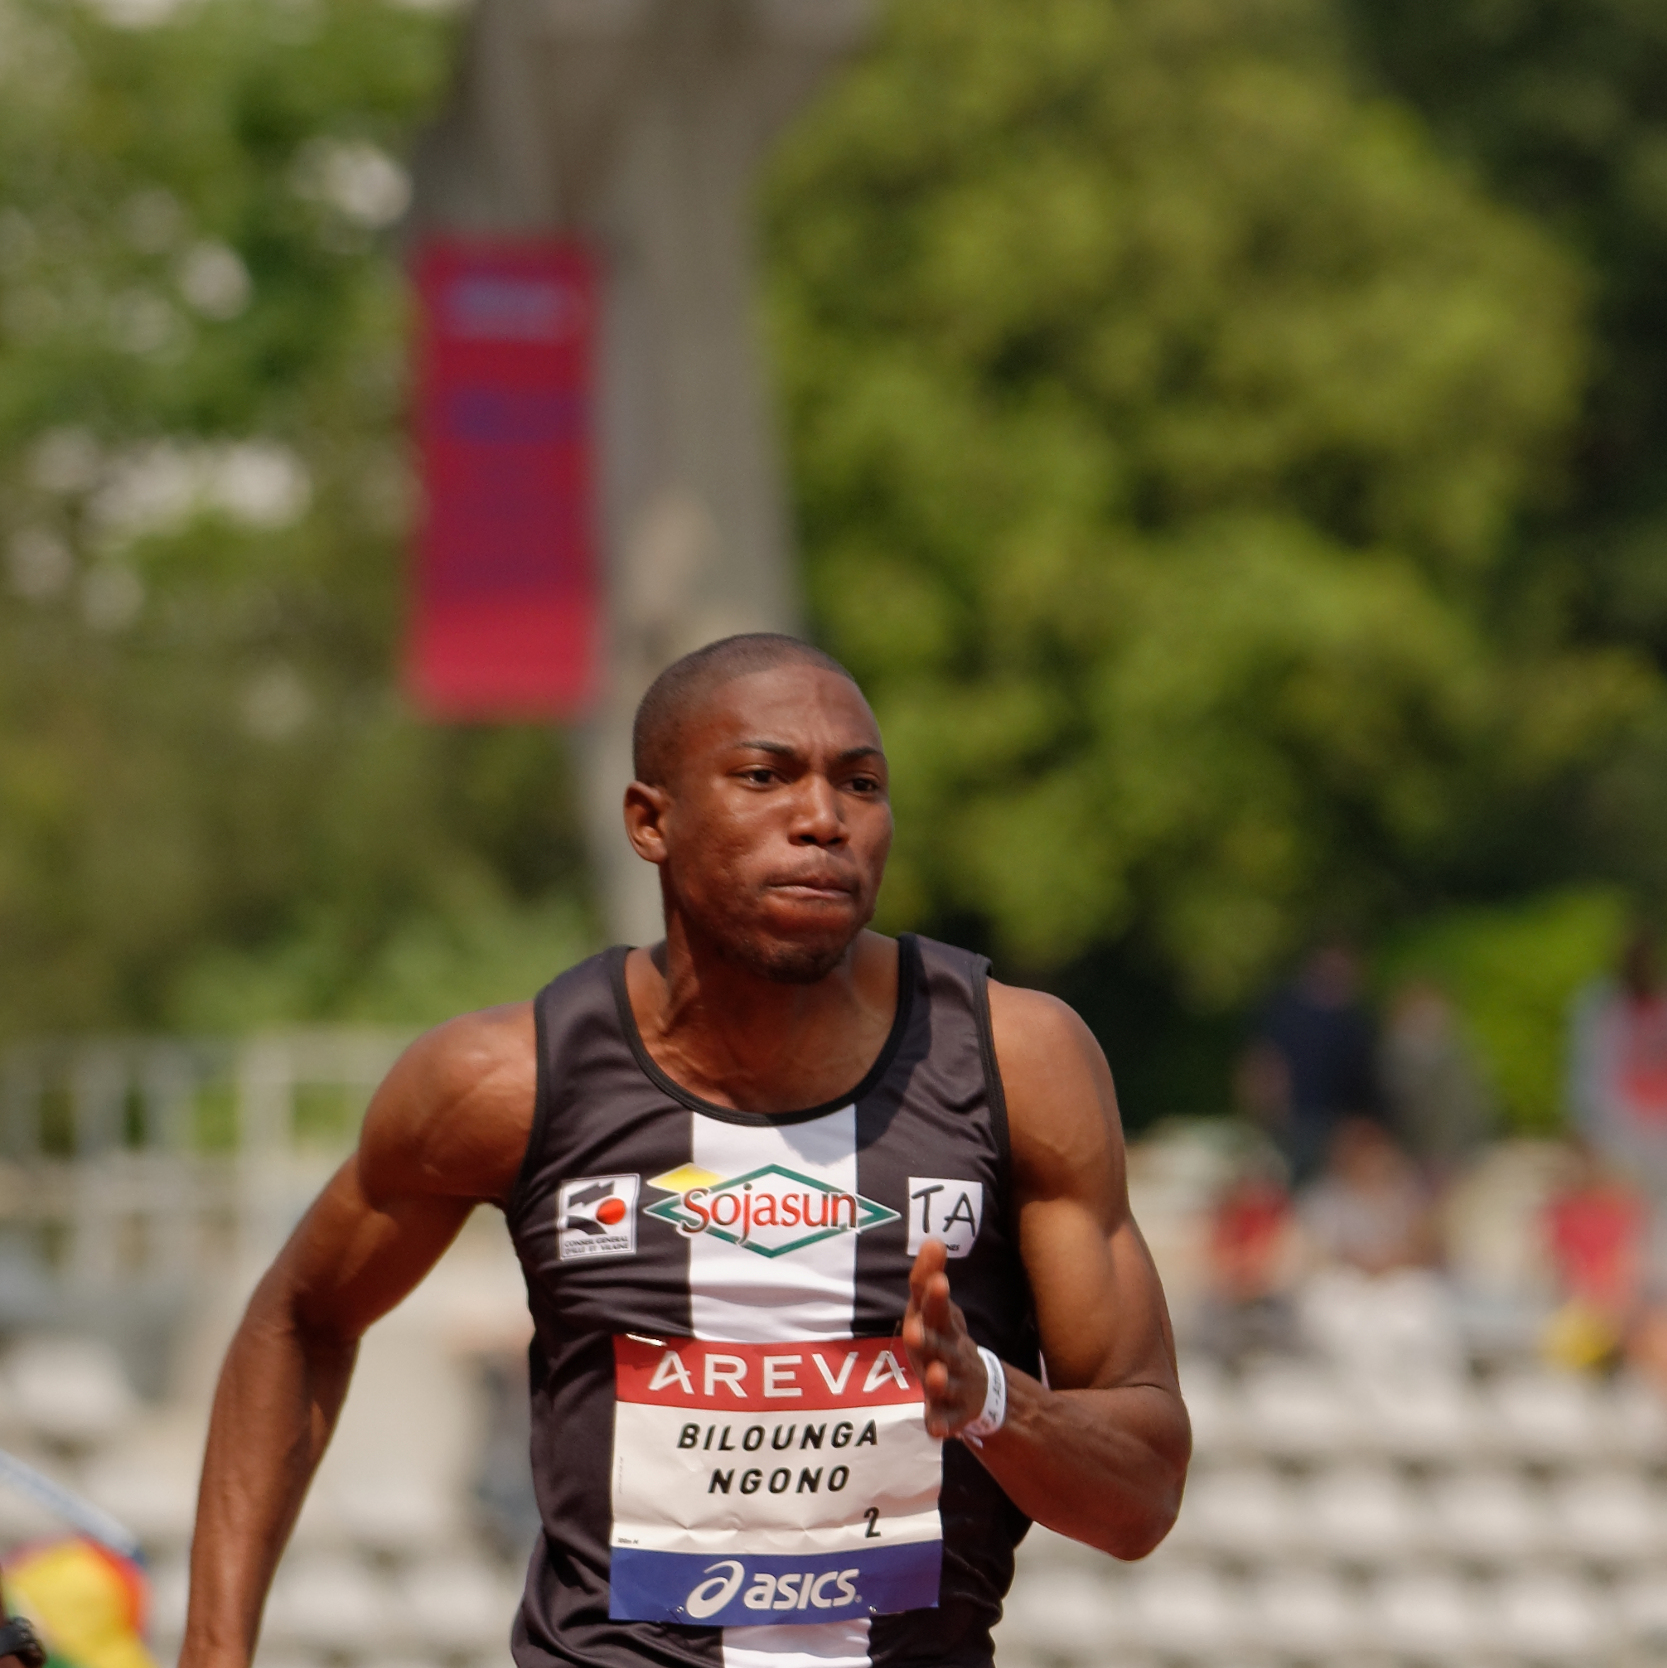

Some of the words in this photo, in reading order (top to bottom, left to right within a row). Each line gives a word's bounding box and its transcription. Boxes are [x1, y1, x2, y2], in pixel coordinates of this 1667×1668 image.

[678, 1181, 859, 1245] Sojasun
[648, 1350, 910, 1399] AREVA
[676, 1419, 879, 1452] BILOUNGA
[707, 1464, 851, 1495] NGONO
[863, 1506, 882, 1539] 2
